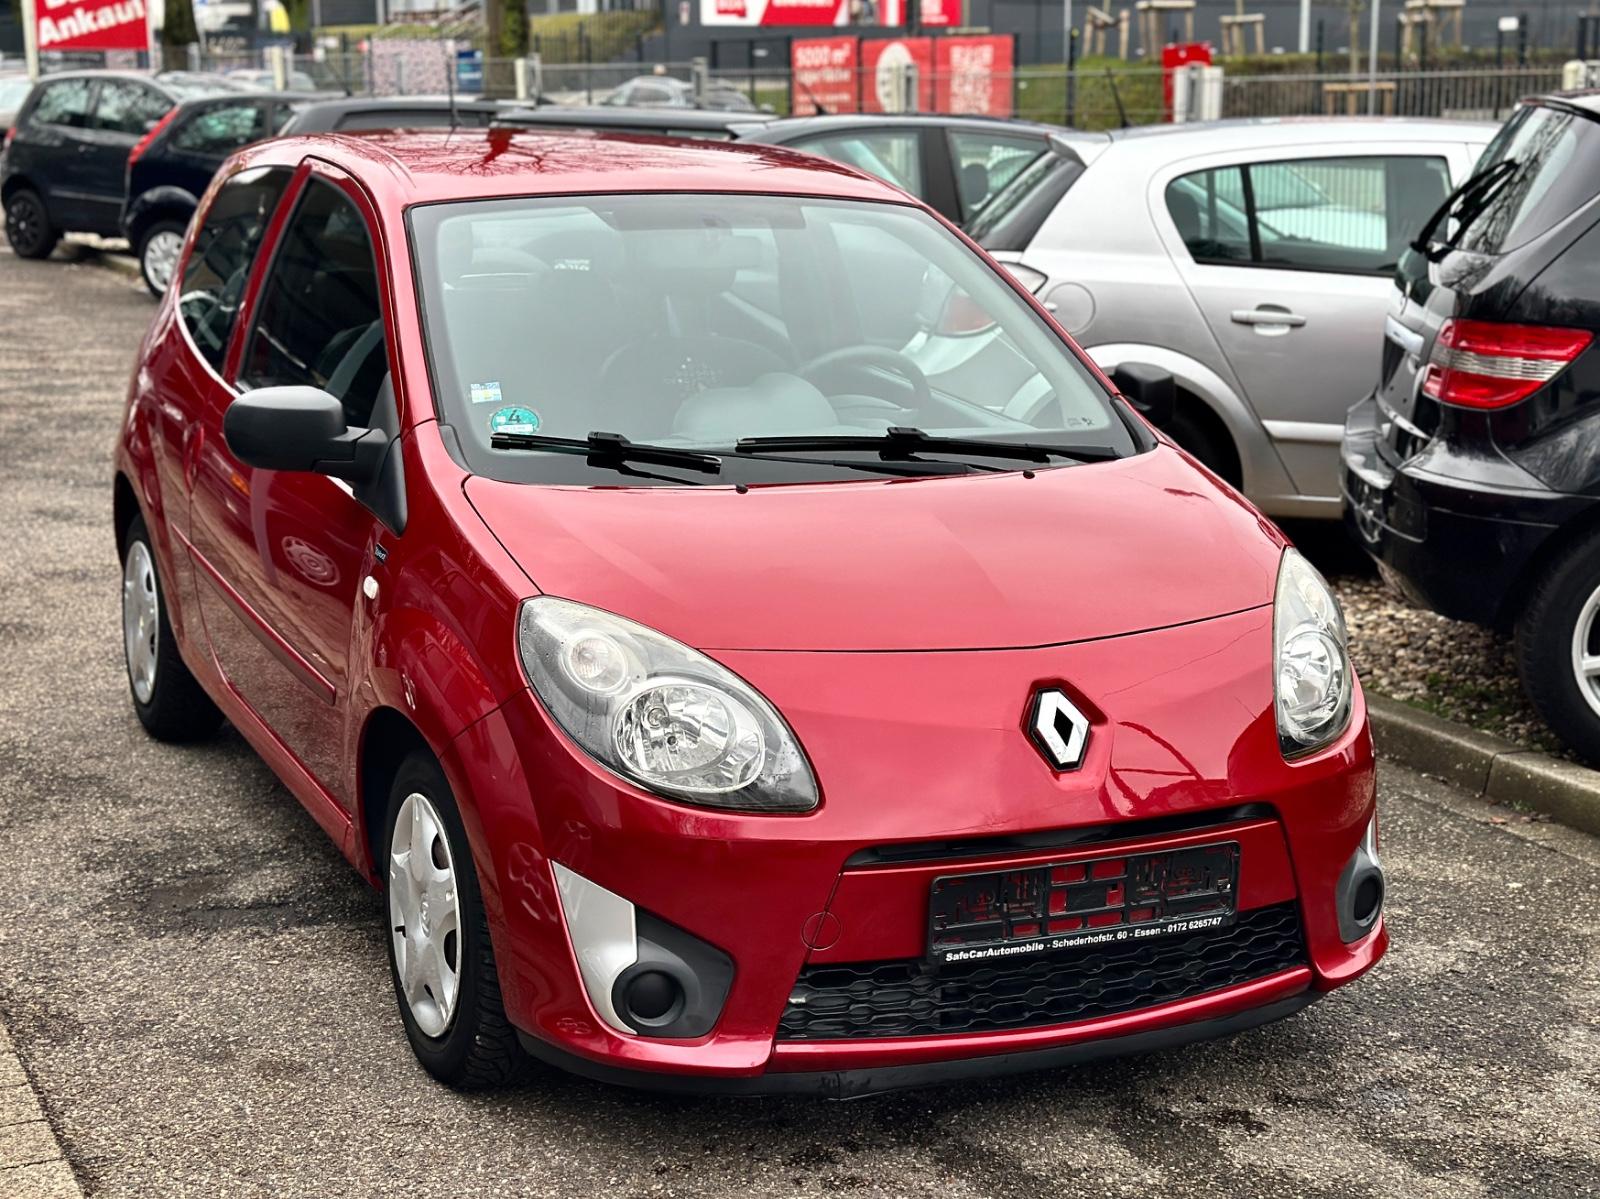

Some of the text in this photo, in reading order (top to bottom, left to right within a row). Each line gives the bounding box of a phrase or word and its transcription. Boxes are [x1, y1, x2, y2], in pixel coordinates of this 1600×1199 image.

[508, 409, 521, 423] 4
[945, 943, 1044, 961] SafeCarAutomobile
[1052, 934, 1115, 948] Schederhofstr.
[1117, 931, 1127, 939] 60
[1134, 928, 1161, 937] Essen
[1167, 922, 1187, 932] 0172
[1188, 917, 1222, 929] 6265747
